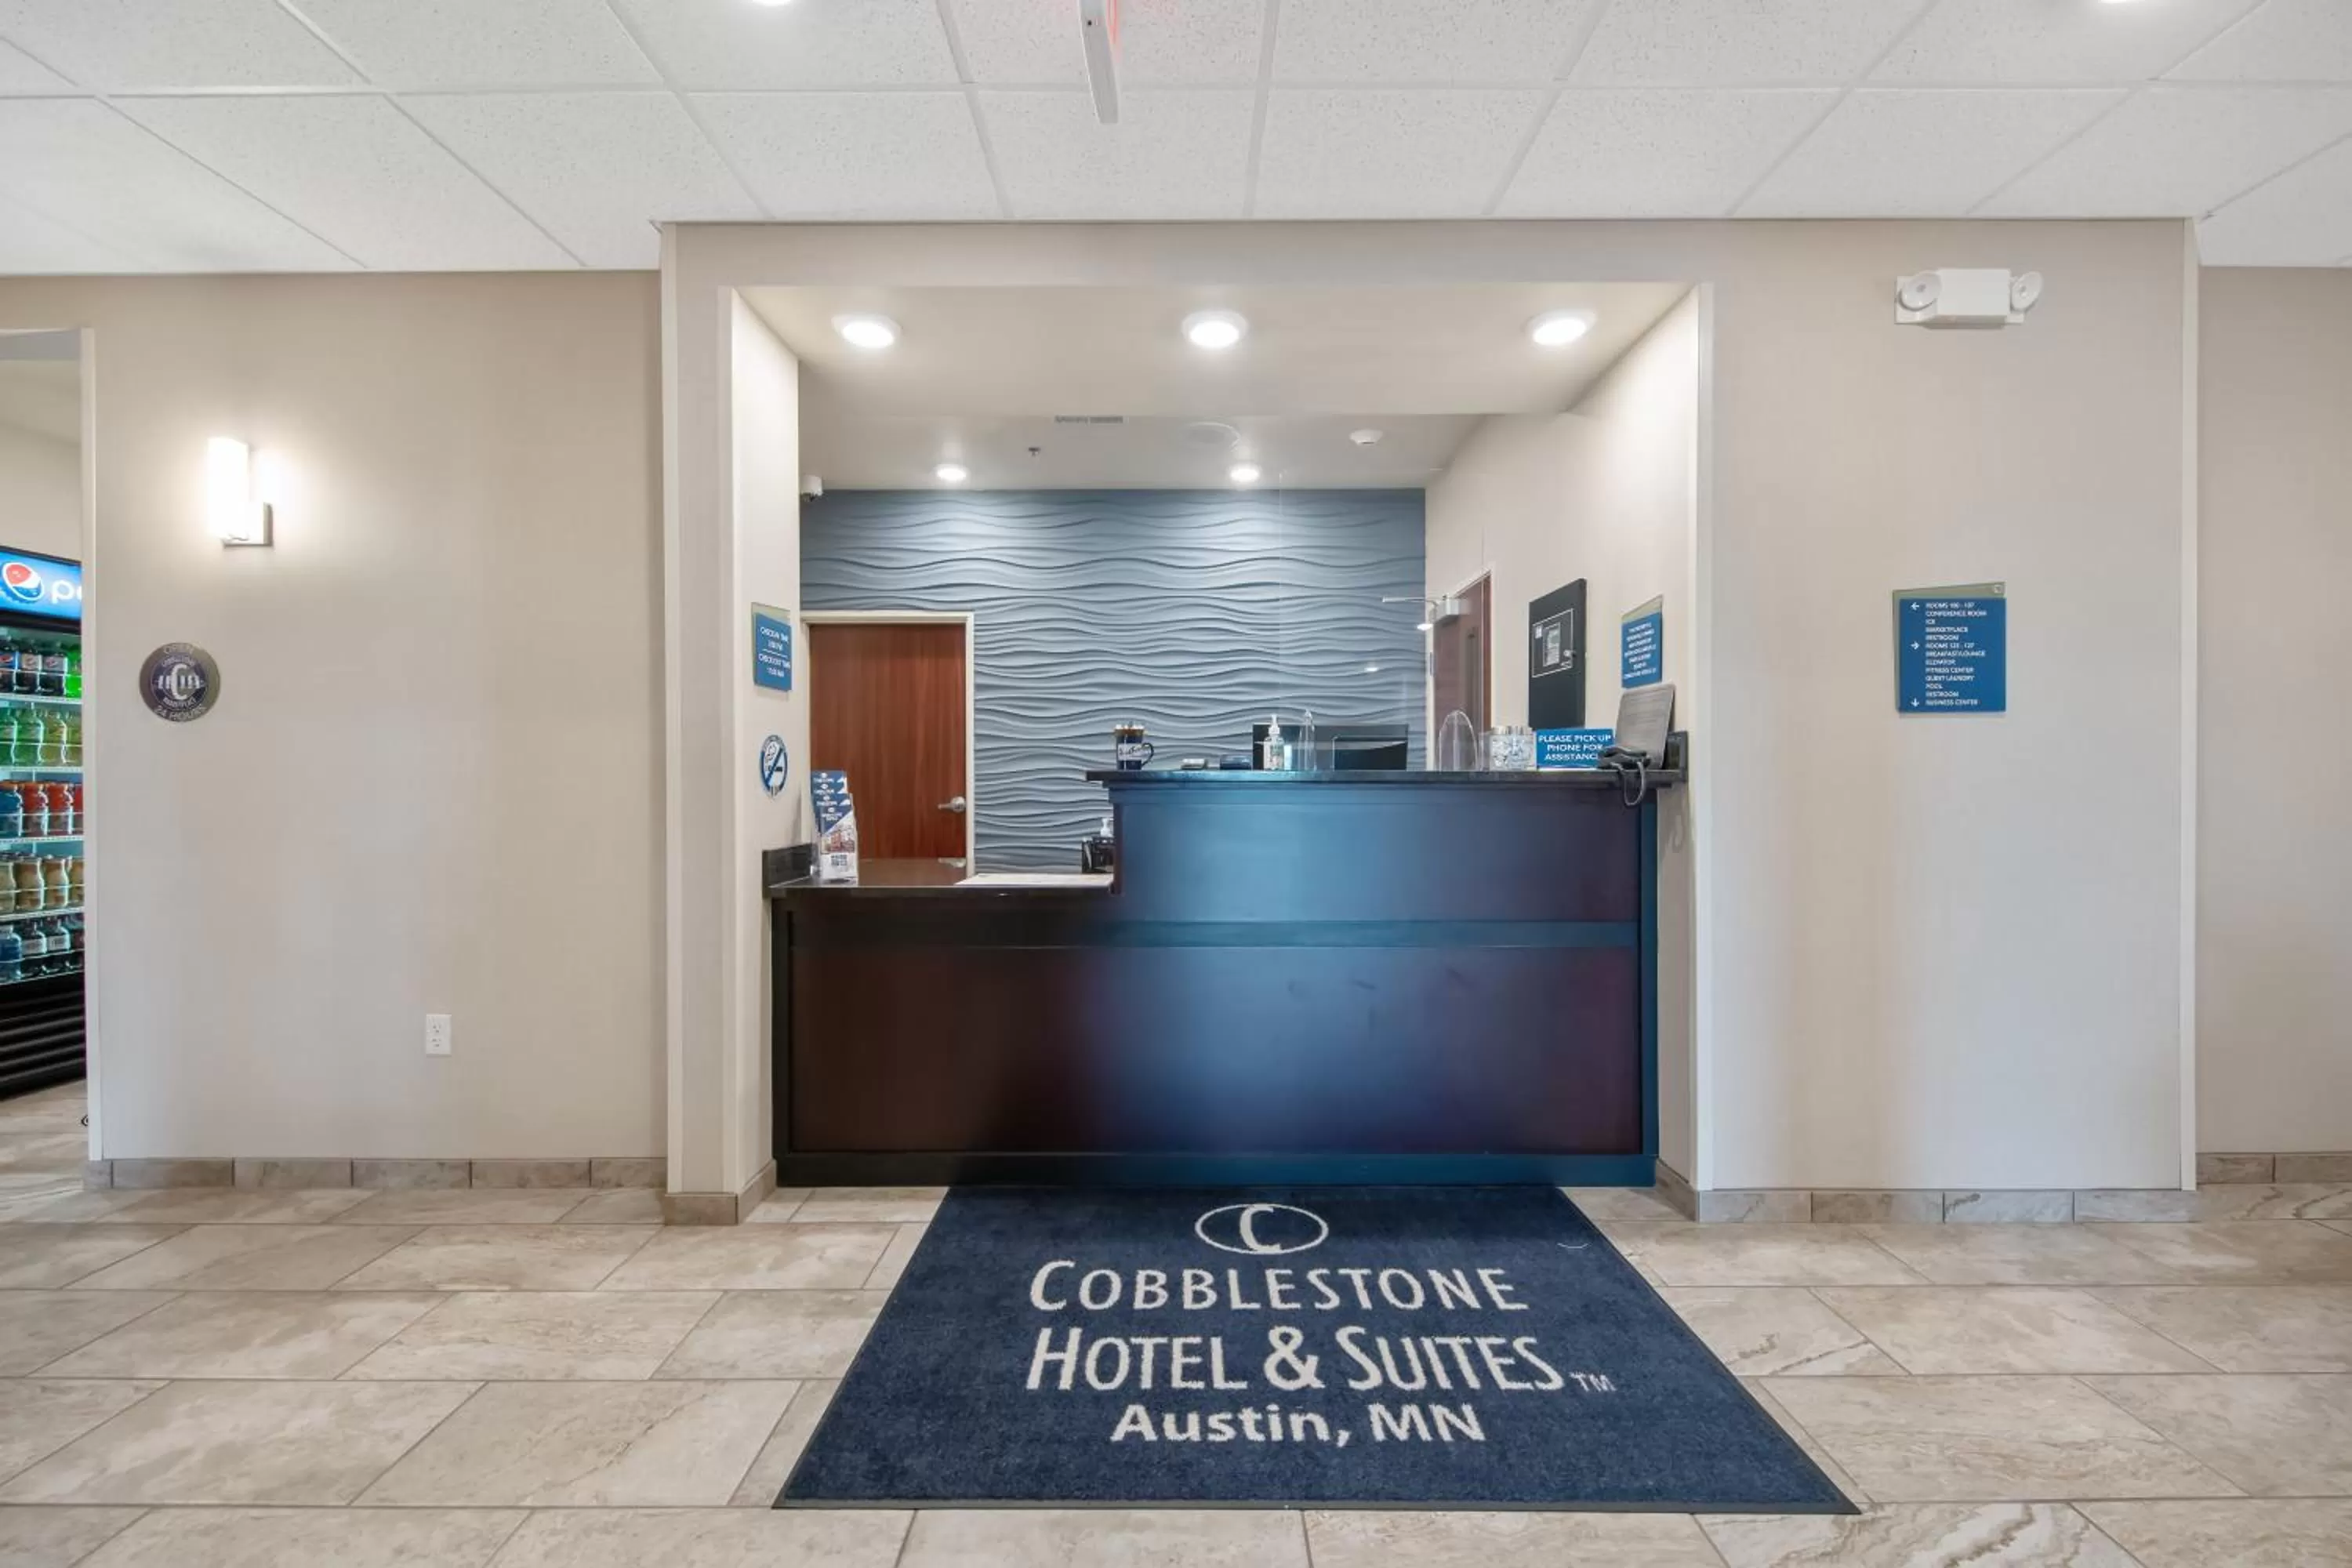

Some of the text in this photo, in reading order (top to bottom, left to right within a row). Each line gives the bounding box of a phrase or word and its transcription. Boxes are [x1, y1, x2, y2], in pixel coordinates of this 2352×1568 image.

[1538, 735, 1572, 743] PLEASE
[1030, 1261, 1529, 1312] COBBLESTONE
[1026, 1327, 1248, 1391] HOTEL
[1264, 1326, 1327, 1392] &
[1337, 1326, 1566, 1392] SUITES
[1110, 1403, 1486, 1449] Austin, MN
